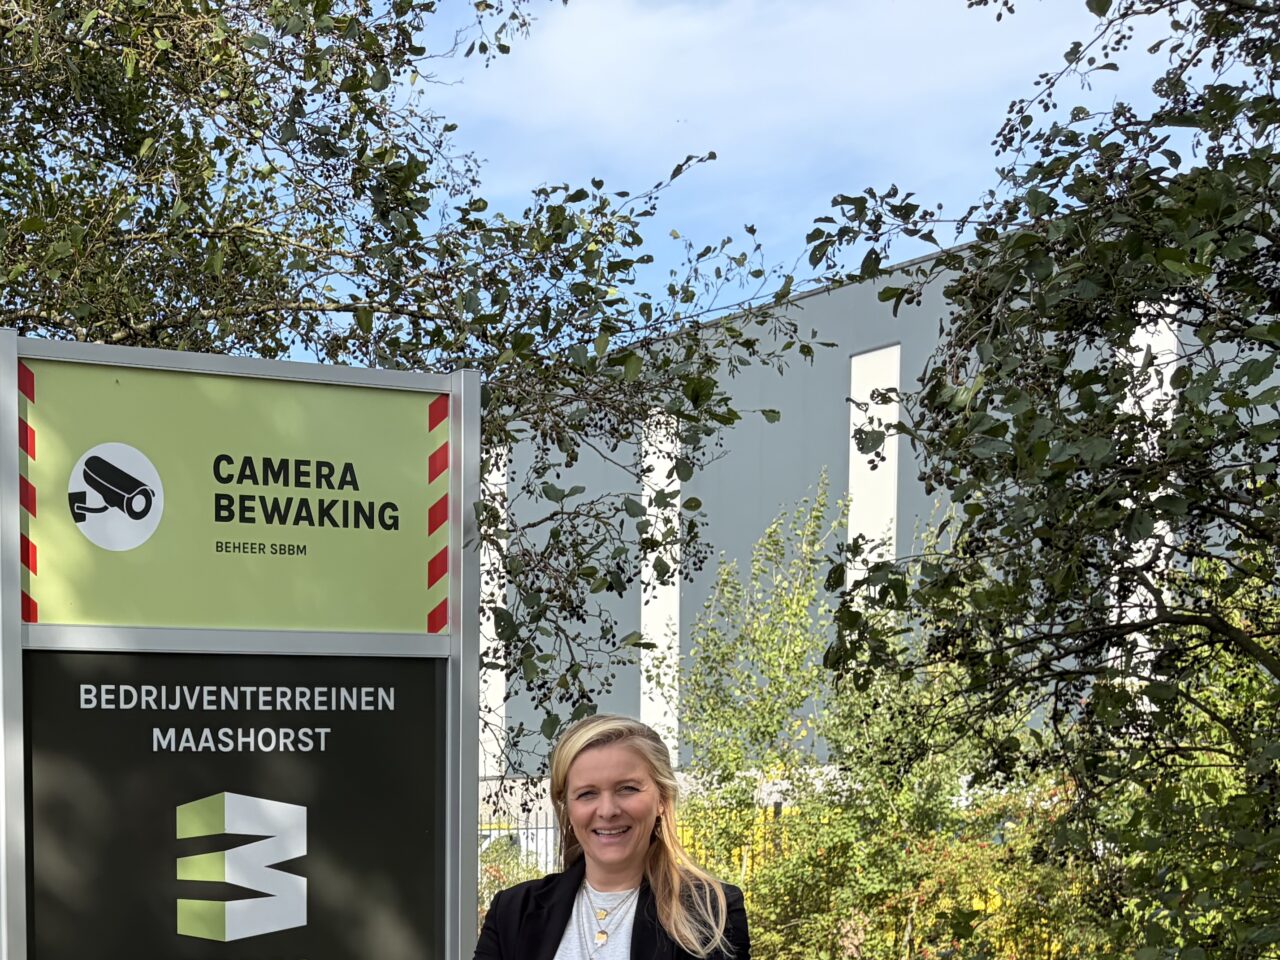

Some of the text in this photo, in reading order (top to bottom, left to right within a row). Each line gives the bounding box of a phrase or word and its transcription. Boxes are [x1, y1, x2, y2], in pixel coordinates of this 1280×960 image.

[212, 453, 360, 492] CAMERA
[214, 493, 400, 531] BEWAKING
[215, 541, 308, 557] BEHEER SBBM
[79, 684, 396, 711] BEDRIJVENTERREINEN
[152, 727, 332, 752] MAASHORST
